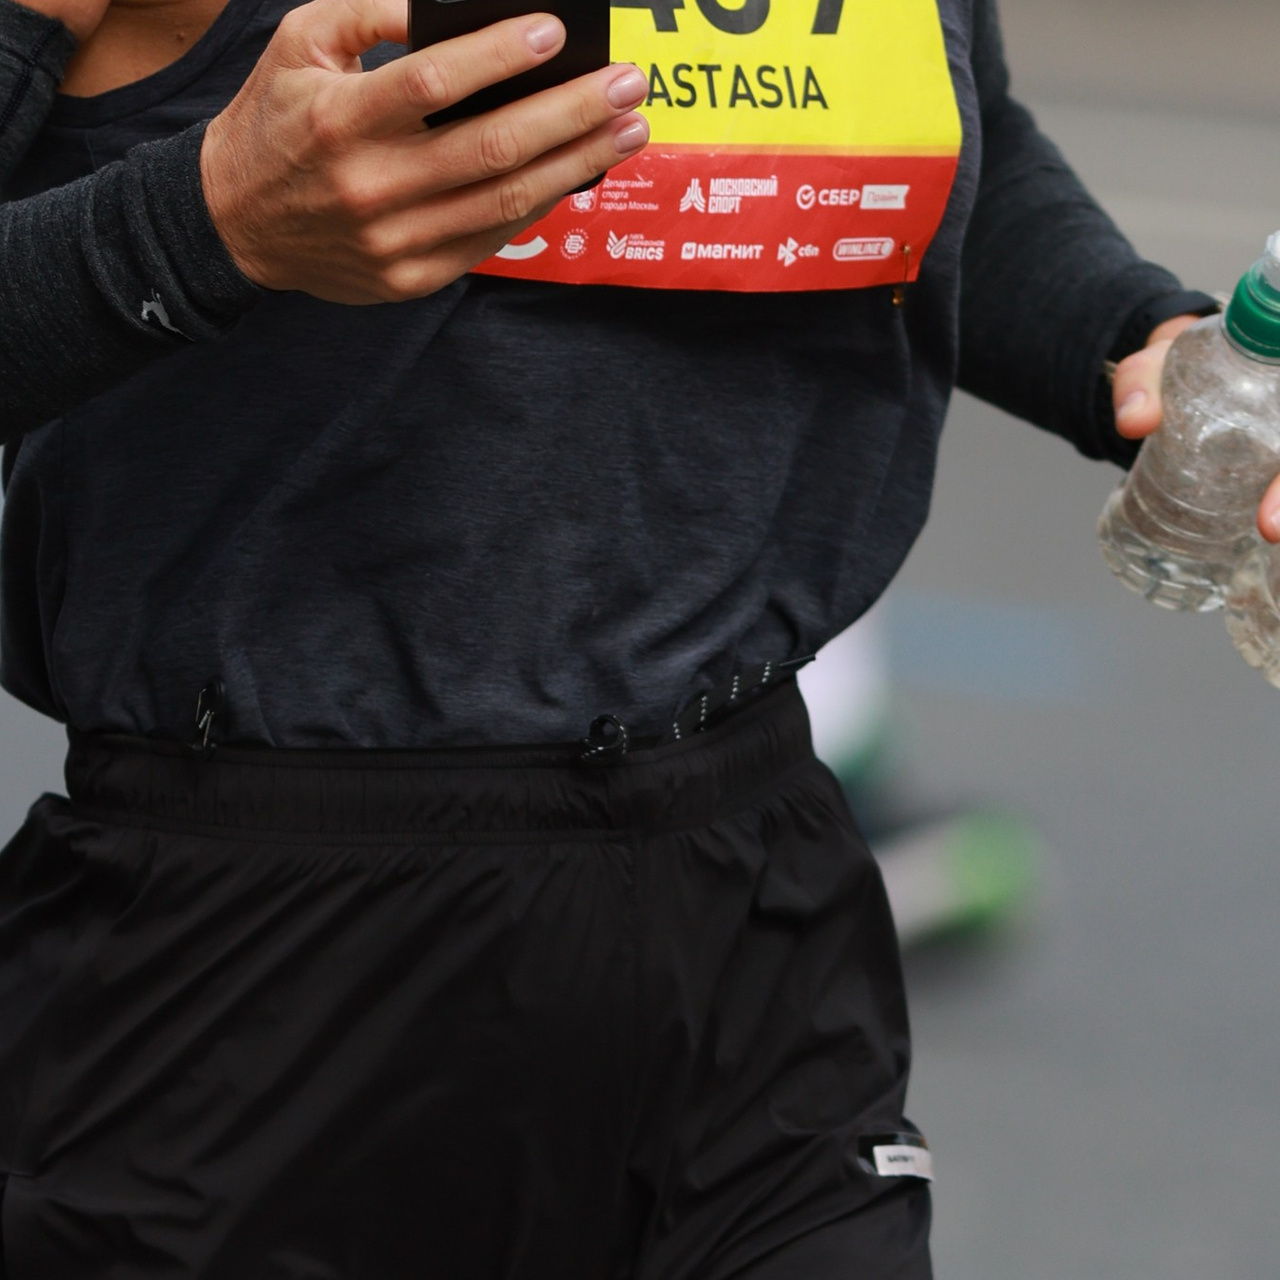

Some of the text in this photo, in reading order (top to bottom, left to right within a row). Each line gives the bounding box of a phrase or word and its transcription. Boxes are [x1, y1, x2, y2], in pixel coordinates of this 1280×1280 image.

[610, 62, 829, 110] ASTASIA
[709, 175, 778, 197] МОСКОВСКИЙ
[601, 190, 629, 200] спорта
[818, 189, 860, 205] СБЕР
[628, 201, 659, 211] Москвы
[708, 195, 742, 213] СПОРТ
[624, 246, 664, 261] BRICS
